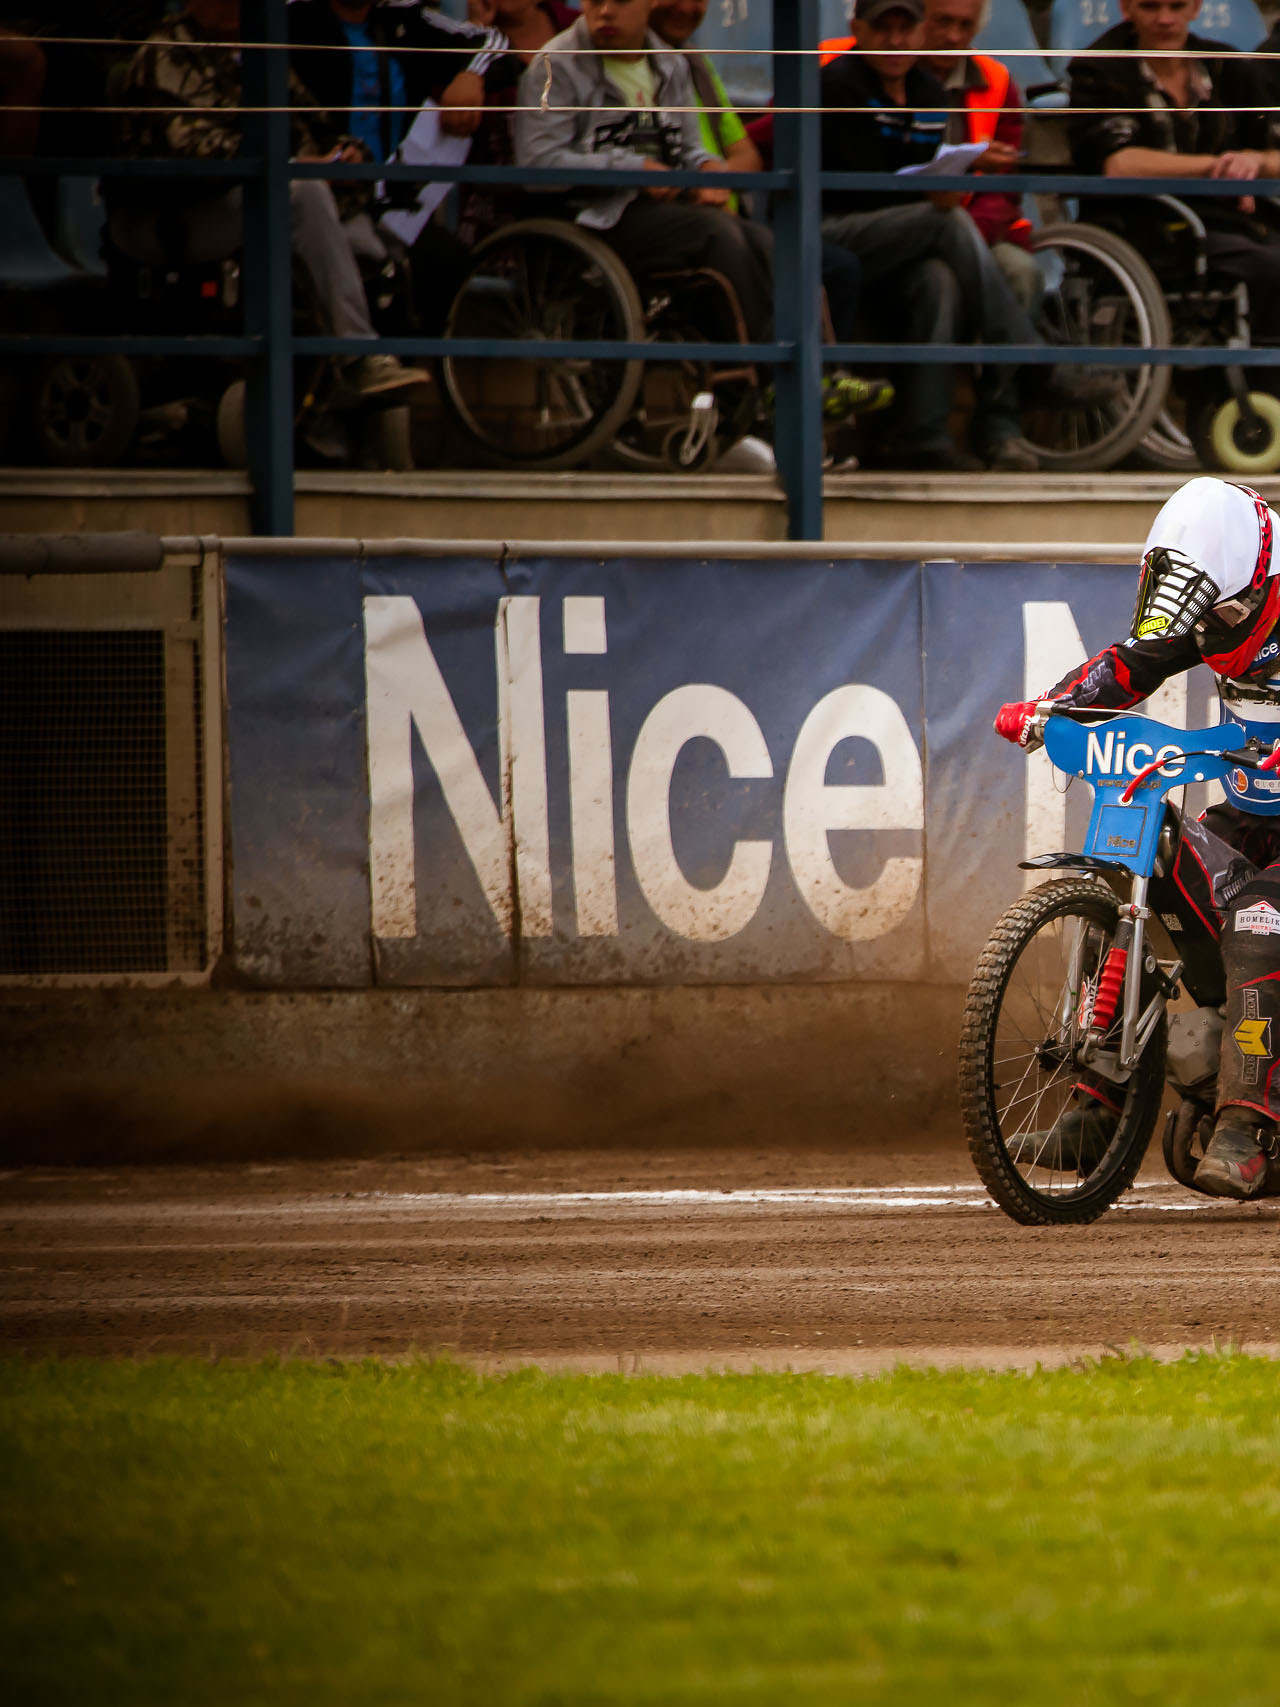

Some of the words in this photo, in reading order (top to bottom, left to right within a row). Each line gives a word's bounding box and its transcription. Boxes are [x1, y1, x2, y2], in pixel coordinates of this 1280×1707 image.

[1140, 617, 1167, 634] SHOEI
[1254, 642, 1279, 662] ice
[1086, 730, 1187, 778] Nice
[363, 595, 925, 943] Nice
[1106, 834, 1137, 849] Nice
[1250, 924, 1273, 932] HOTEL
